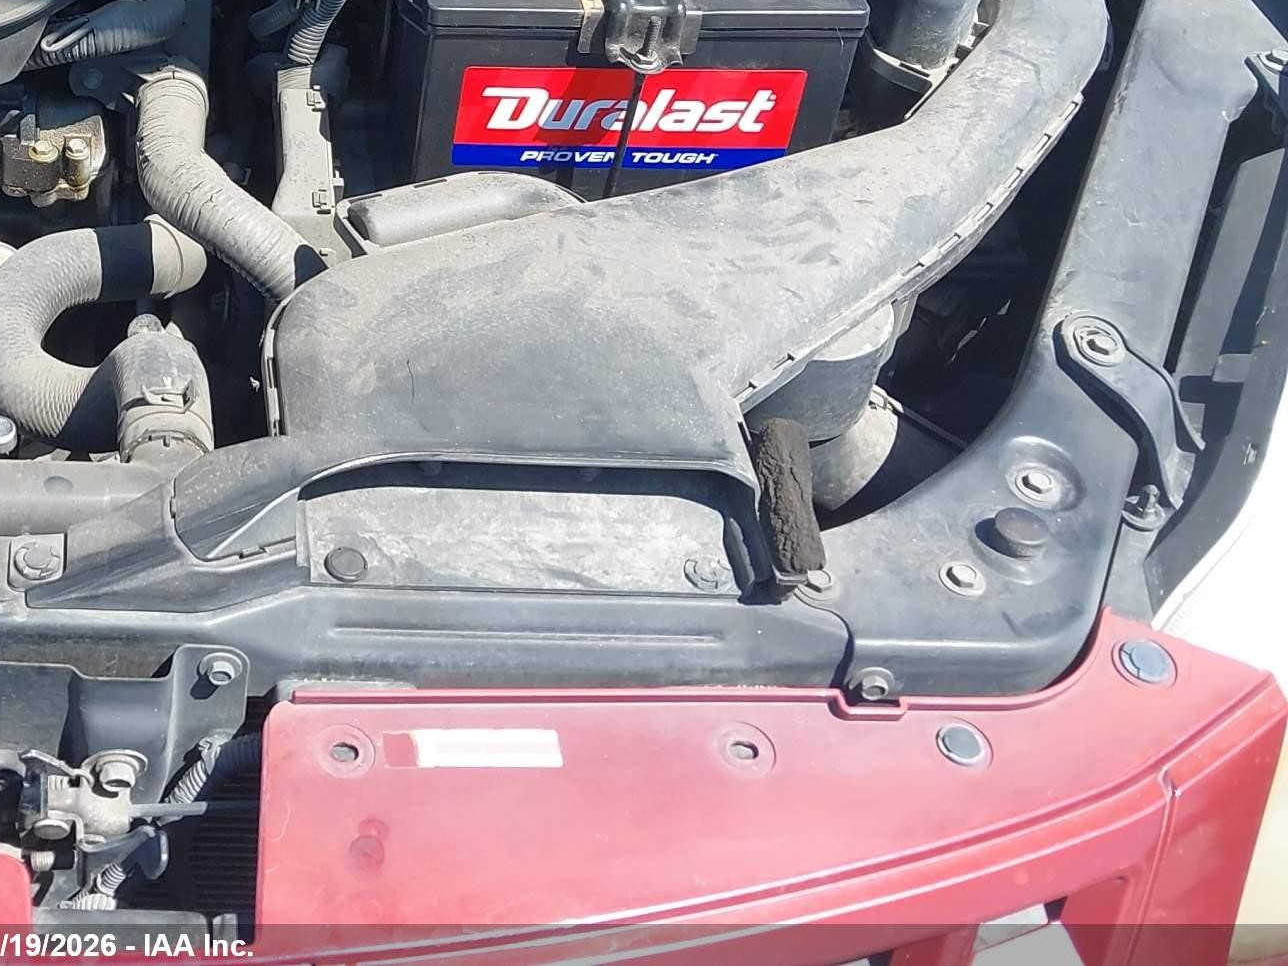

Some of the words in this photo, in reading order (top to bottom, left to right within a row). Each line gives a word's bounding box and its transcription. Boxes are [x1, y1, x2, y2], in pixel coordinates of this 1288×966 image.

[482, 87, 776, 132] Duralast
[520, 150, 614, 163] PROVEN
[632, 151, 715, 164] TOUGH
